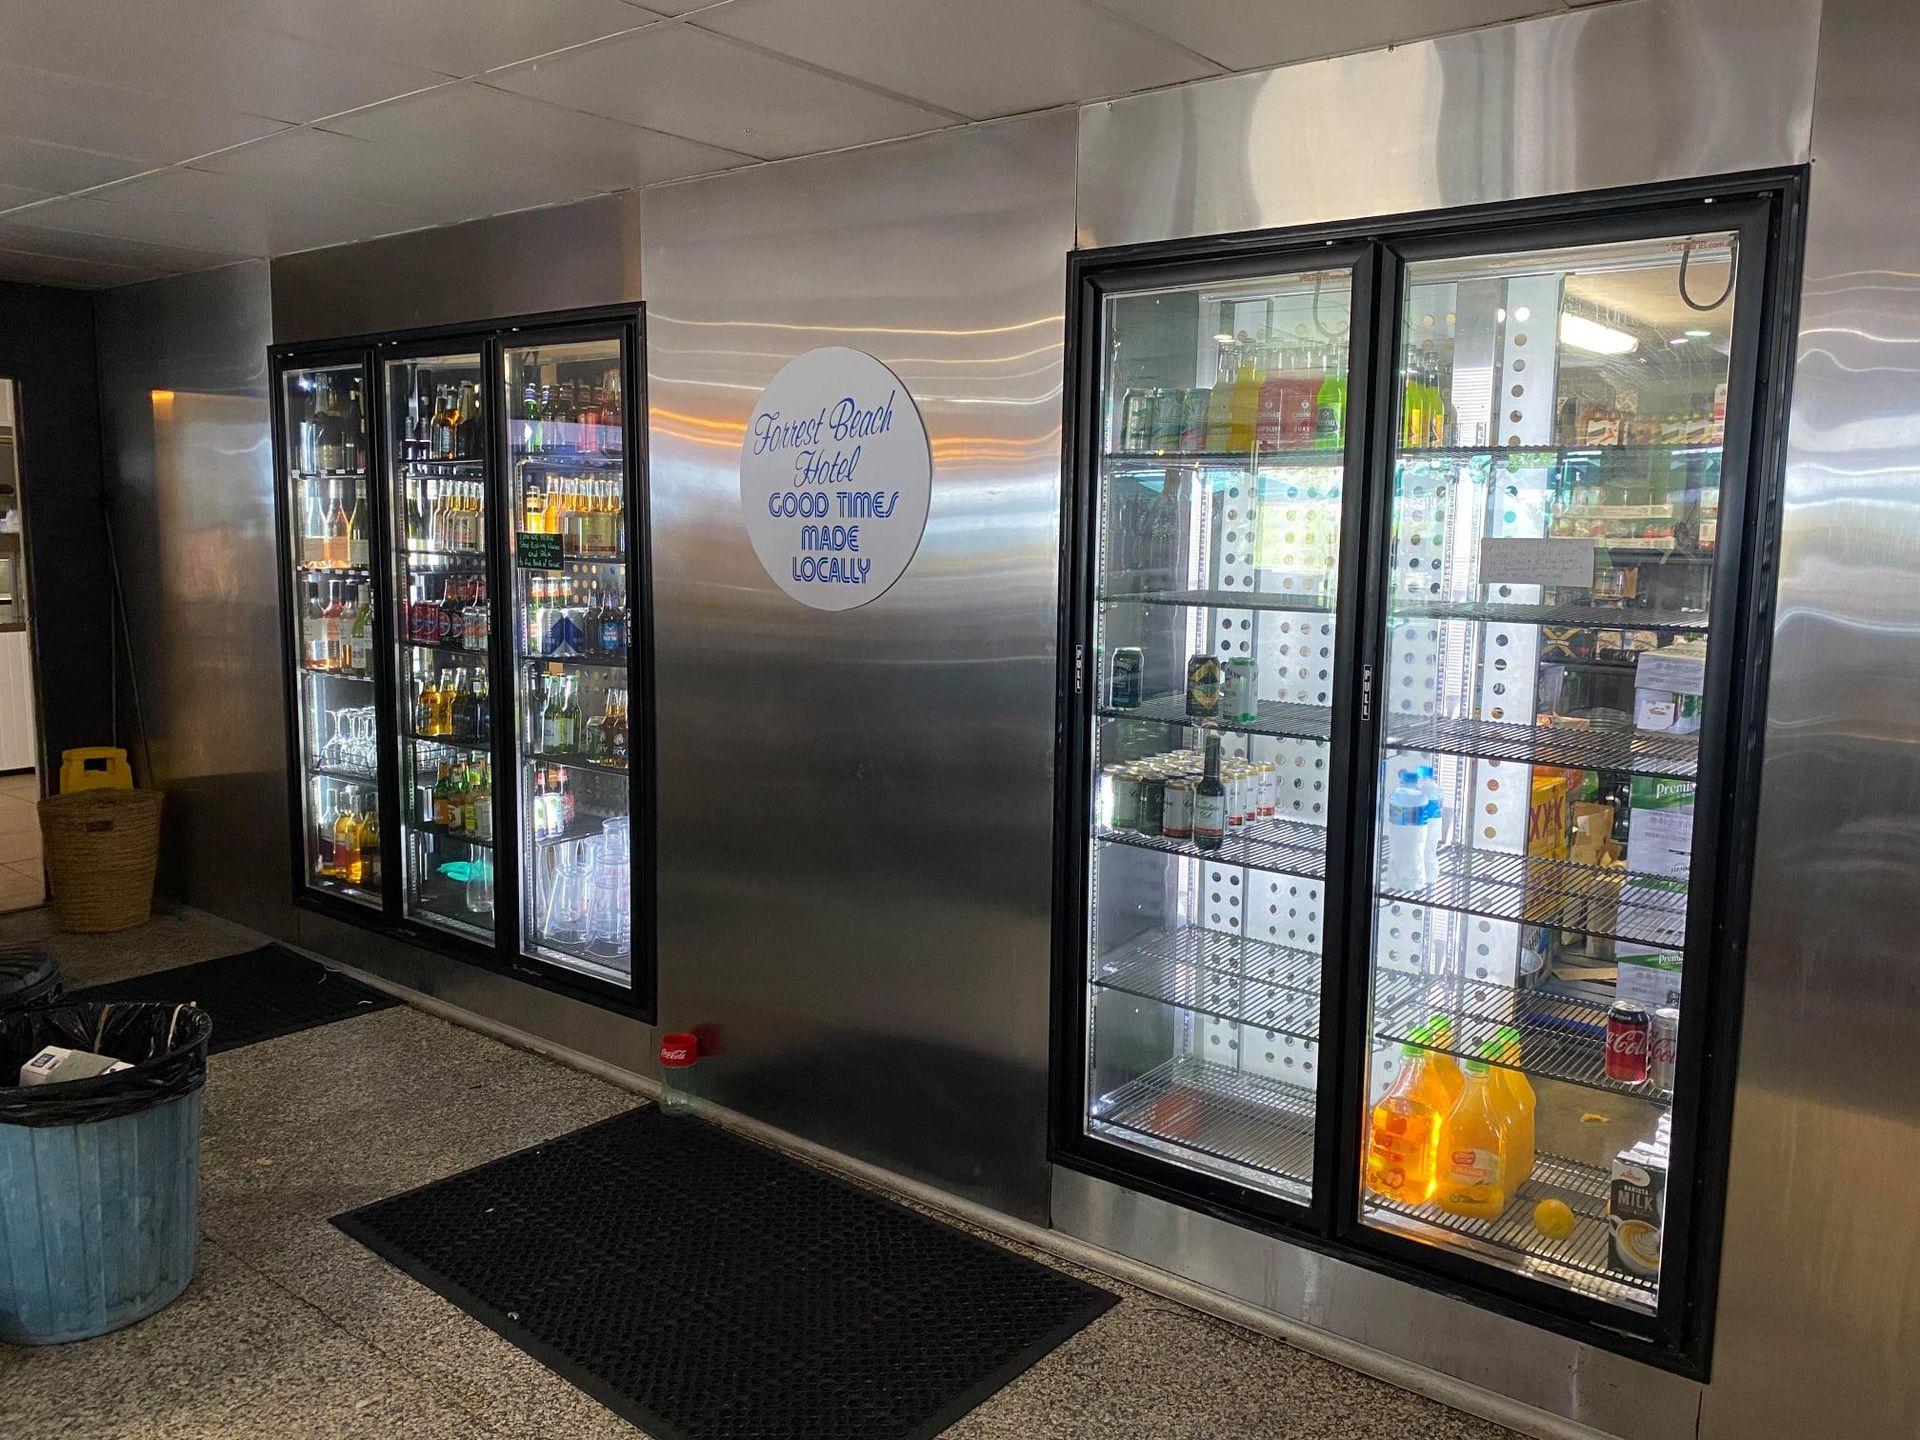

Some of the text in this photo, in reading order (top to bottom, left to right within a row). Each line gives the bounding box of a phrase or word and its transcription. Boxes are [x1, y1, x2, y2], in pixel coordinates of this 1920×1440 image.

[754, 390, 896, 456] Forrest Beach
[794, 445, 861, 488] Hotel
[769, 491, 900, 518] GOOD TIMES
[801, 525, 860, 551] MADE
[792, 556, 871, 584] LOCALLY
[1618, 1189, 1653, 1212] MILK
